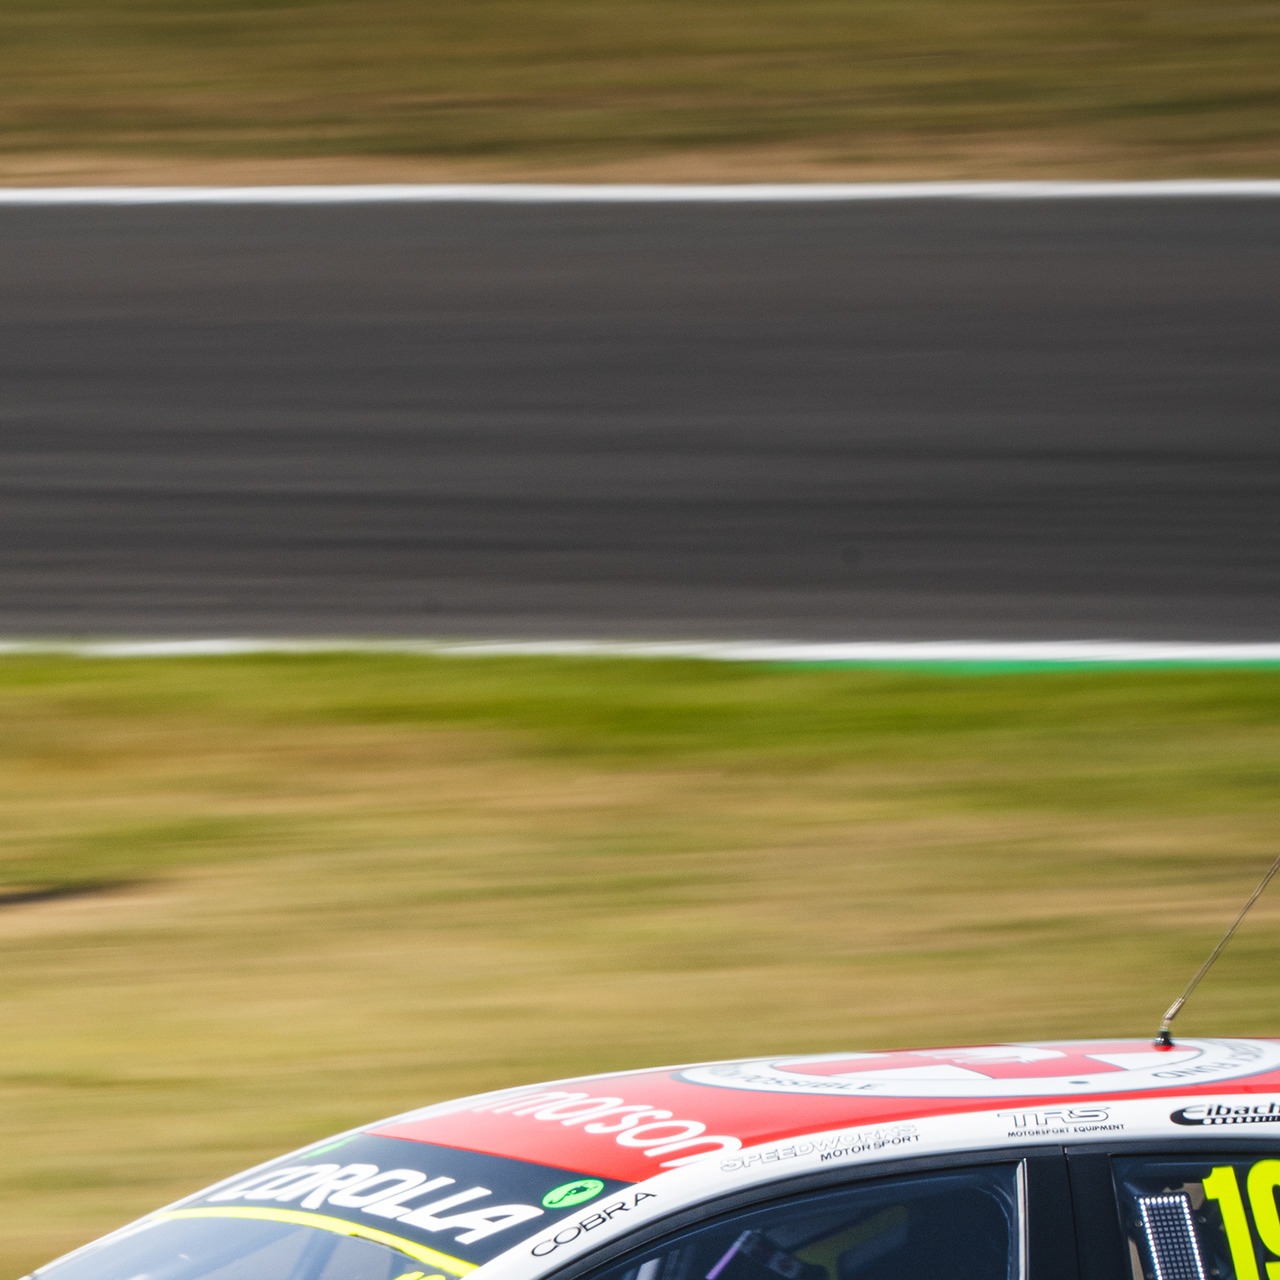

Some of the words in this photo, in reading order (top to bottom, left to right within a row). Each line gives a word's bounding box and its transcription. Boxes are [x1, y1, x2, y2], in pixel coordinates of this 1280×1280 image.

[470, 1090, 743, 1168] morson
[720, 1124, 918, 1172] SPEEDWORKS
[819, 1134, 920, 1162] MOTORSPORT
[1007, 1127, 1070, 1138] MOTORSPORT
[1073, 1123, 1125, 1134] EQUIPMENT
[206, 1162, 546, 1245] COROLLA
[530, 1191, 658, 1258] COBRA
